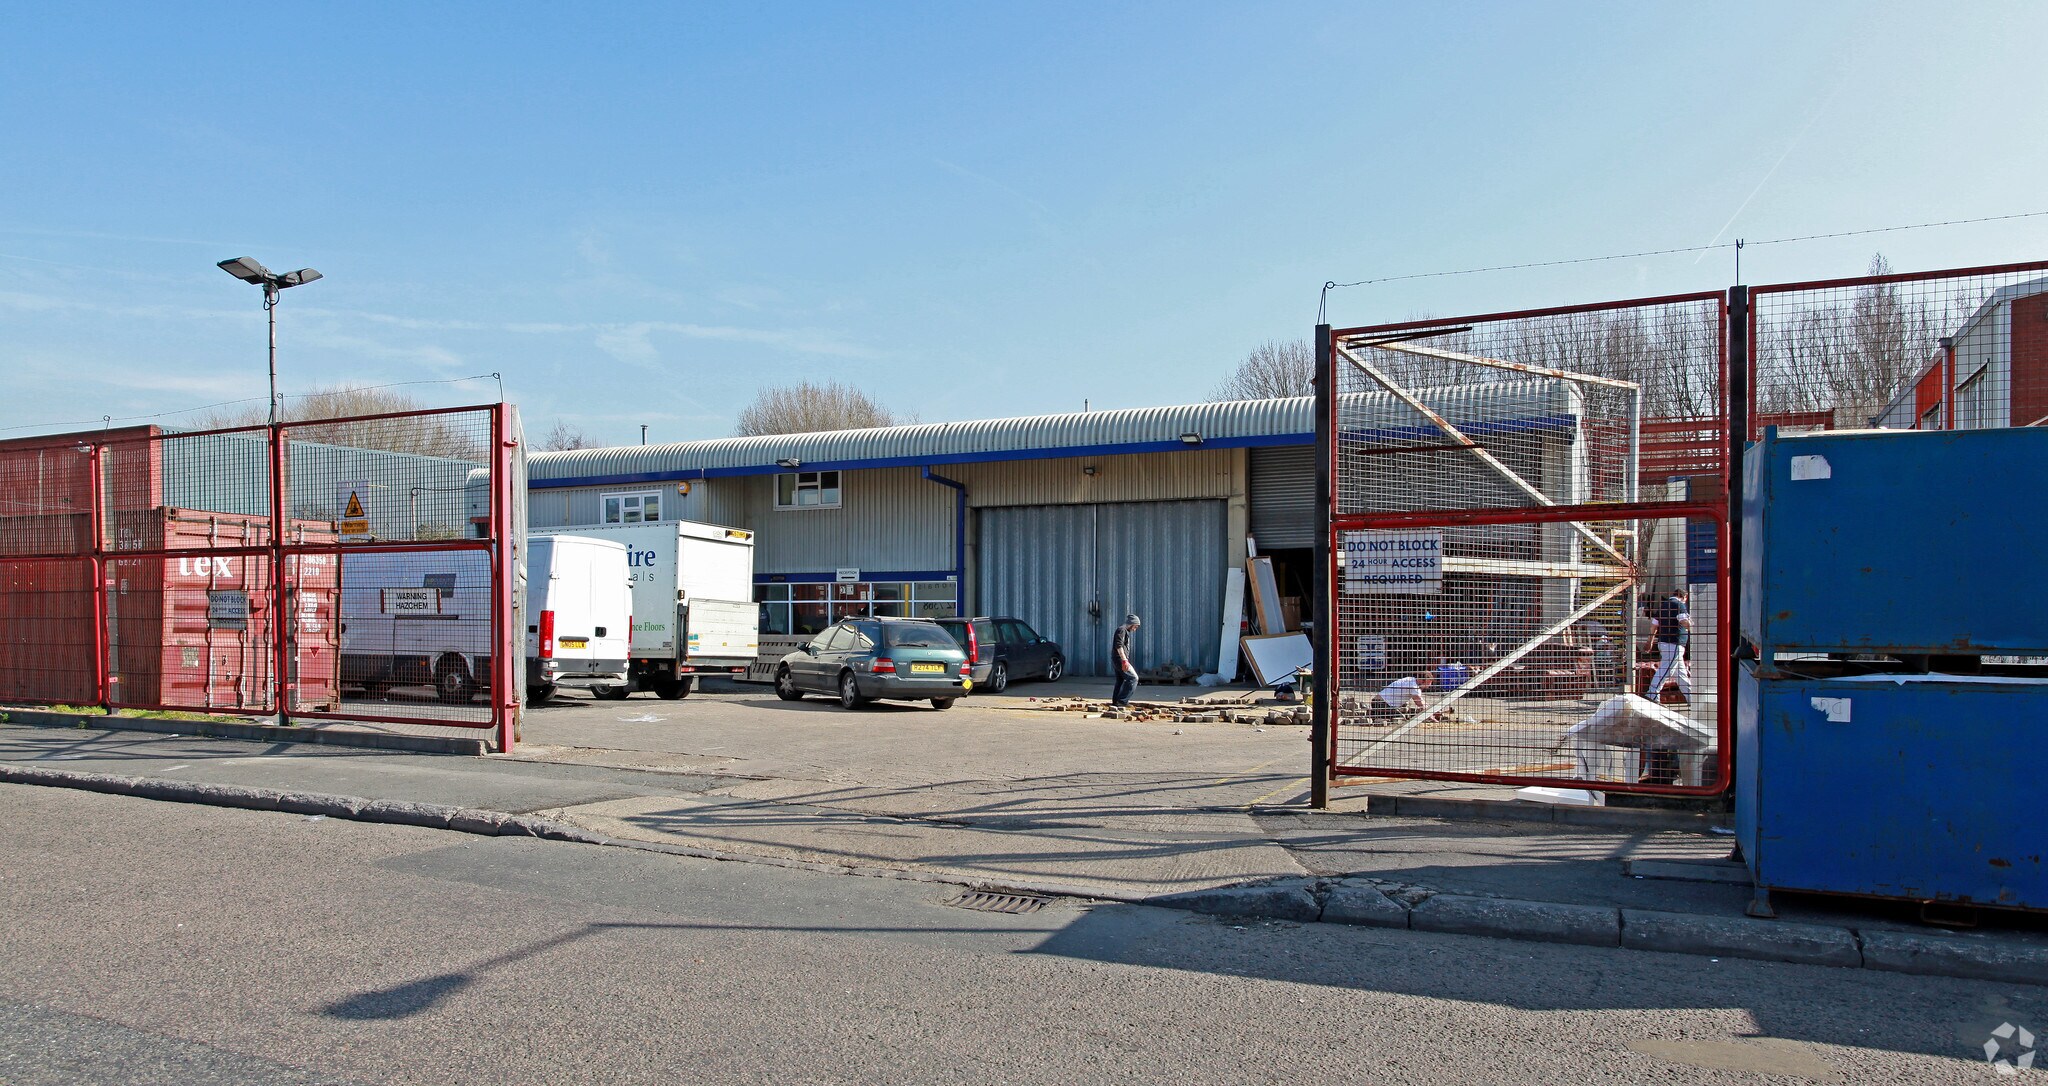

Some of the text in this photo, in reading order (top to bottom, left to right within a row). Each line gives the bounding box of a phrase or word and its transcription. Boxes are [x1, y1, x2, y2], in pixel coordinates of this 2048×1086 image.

[1348, 540, 1438, 552] DO NOT BLOCK
[627, 543, 656, 567] ire
[1352, 559, 1365, 569] 24
[1391, 558, 1436, 568] ACCESS
[1364, 574, 1423, 585] REQUIRED
[231, 596, 247, 604] BLOCK
[396, 592, 427, 600] WARNING
[395, 602, 428, 610] HAZCHEM
[644, 621, 666, 632] Floors
